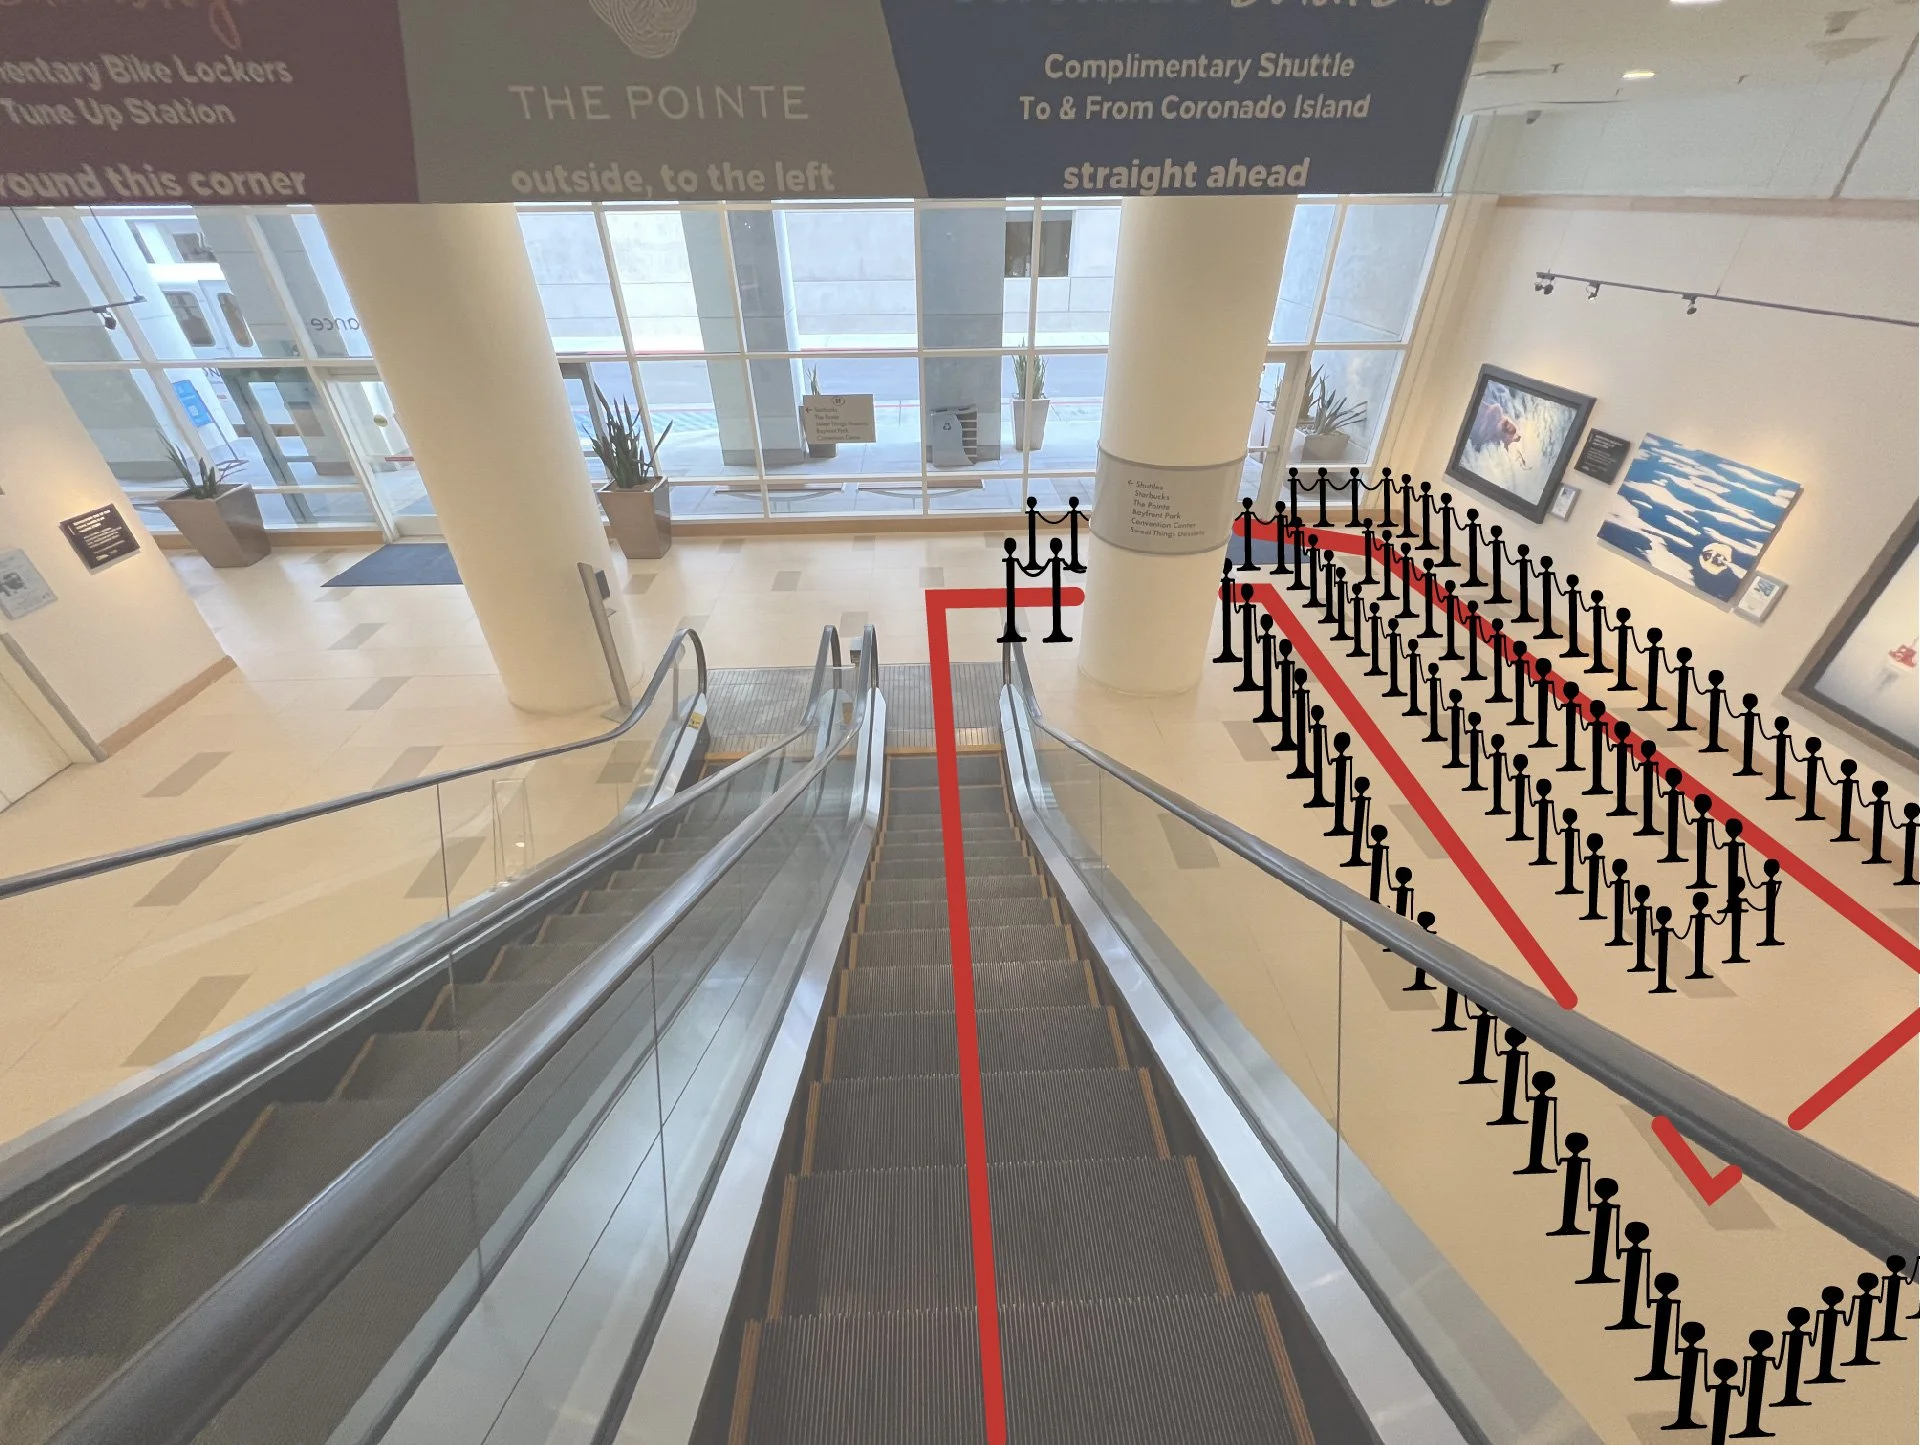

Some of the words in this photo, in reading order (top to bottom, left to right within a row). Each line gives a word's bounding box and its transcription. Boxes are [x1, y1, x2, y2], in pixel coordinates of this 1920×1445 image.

[101, 54, 173, 84] Bike
[172, 54, 294, 83] Lockers
[1045, 53, 1252, 84] Complimentary
[1258, 52, 1355, 77] Shuttle
[0, 97, 77, 125] Tune
[74, 97, 124, 131] Up
[124, 97, 236, 126] Station
[507, 85, 610, 120] THE
[626, 85, 810, 120] POINTE
[1019, 96, 1051, 120] To
[1059, 96, 1076, 120] &
[1086, 96, 1153, 120] From
[1161, 94, 1287, 120] Coronado
[1294, 93, 1371, 119] Island
[102, 163, 184, 197] this
[188, 170, 306, 197] corner
[511, 162, 653, 198] outside,
[660, 163, 698, 193] to
[706, 162, 766, 193] the
[775, 161, 835, 193] left
[1063, 158, 1198, 195] straight
[1206, 157, 1311, 188] ahead
[1133, 499, 1146, 508] The
[1135, 490, 1170, 500] Starbucks
[1131, 518, 1171, 528] Convention
